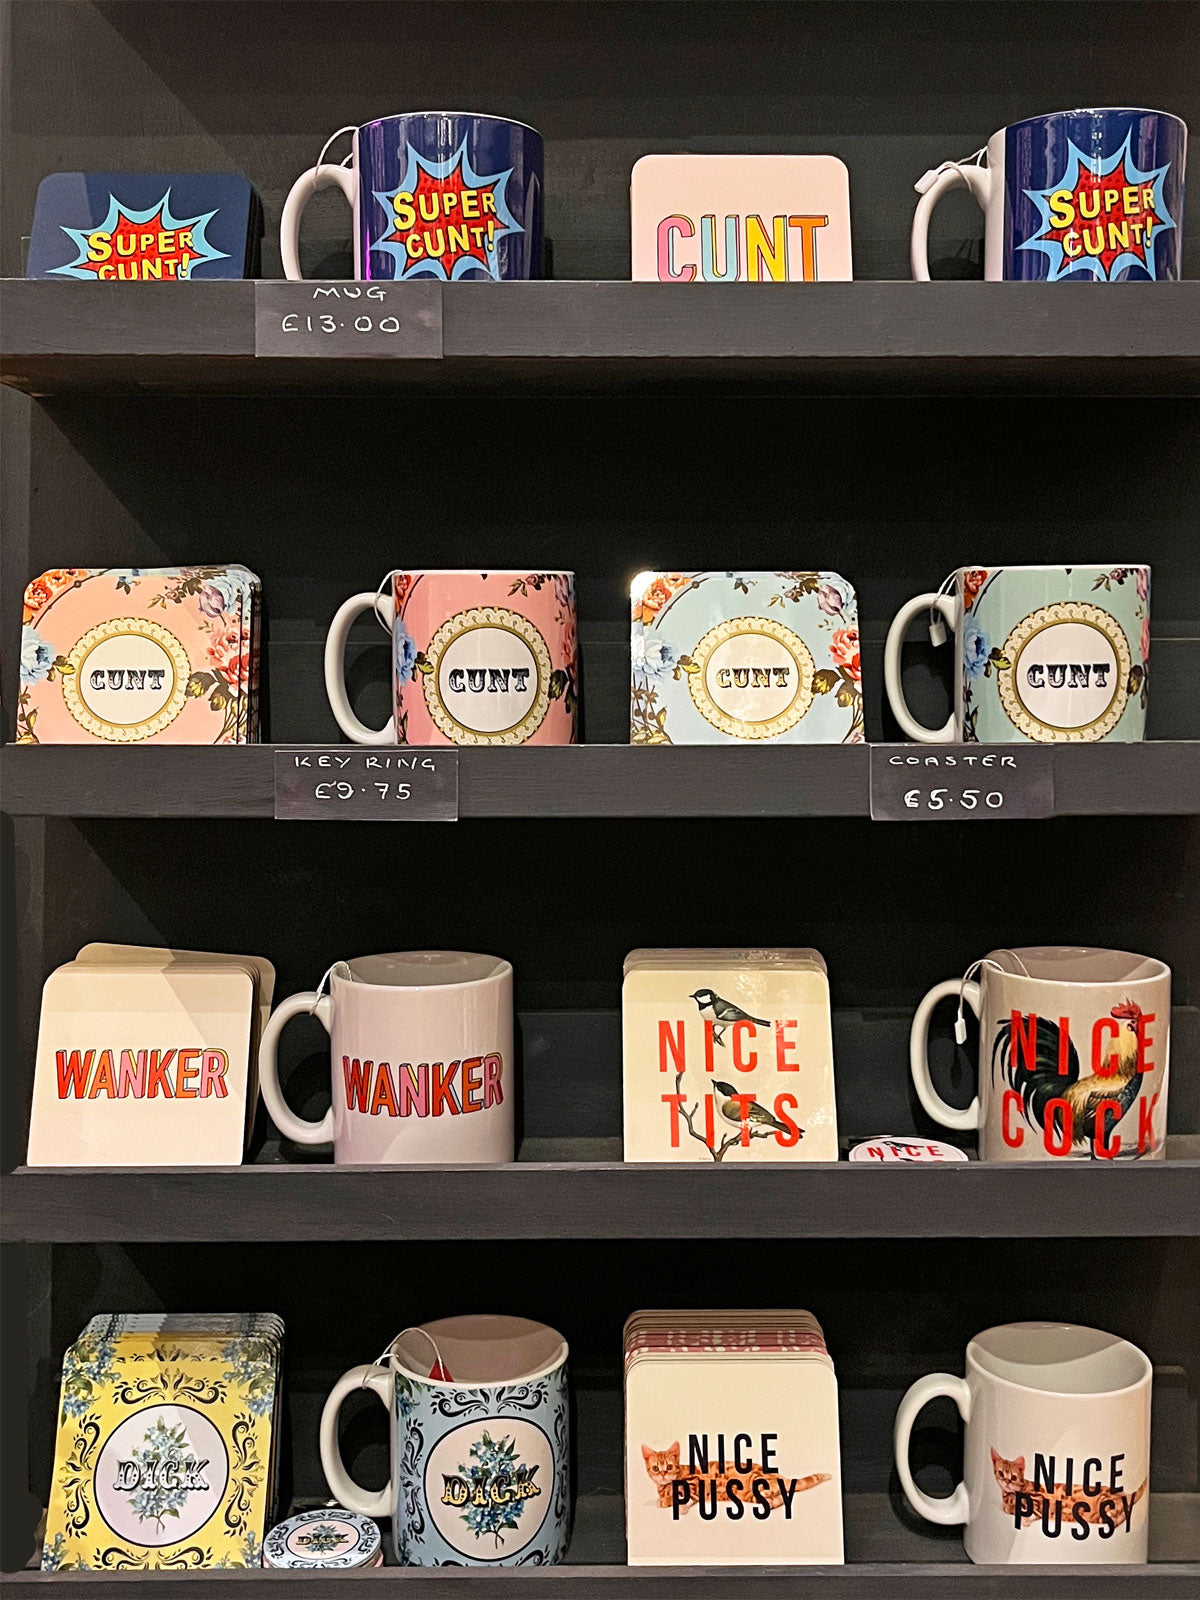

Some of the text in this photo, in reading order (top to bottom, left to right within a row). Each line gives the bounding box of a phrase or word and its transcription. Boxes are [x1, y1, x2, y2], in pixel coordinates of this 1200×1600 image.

[393, 188, 497, 231] SUPER
[1047, 184, 1156, 228] SUPER
[86, 229, 195, 263] SUPER
[405, 219, 496, 261] CUNT!
[656, 214, 829, 282] CUNT
[1061, 215, 1154, 258] CUNT!
[313, 286, 388, 302] MUG
[90, 669, 165, 692] CUNT
[448, 667, 531, 693] CUNT
[716, 666, 790, 688] CUNT
[1027, 663, 1110, 689] CUNT
[294, 754, 437, 773] KEY RING
[888, 754, 1018, 769] COASTER
[658, 1019, 800, 1073] NICE
[1009, 1009, 1157, 1077] NICE
[55, 1048, 230, 1100] WANKER
[342, 1051, 505, 1118] WANKER
[661, 1092, 802, 1148] TITS
[1002, 1089, 1161, 1160] COCK
[866, 1145, 944, 1158] NICE
[688, 1432, 780, 1475] NICE
[1033, 1453, 1127, 1497] NICE
[112, 1459, 211, 1492] DICK
[441, 1465, 543, 1509] DICK
[672, 1478, 799, 1521] PUSSY
[1015, 1498, 1136, 1541] PUSSY
[298, 1533, 350, 1547] DICK
